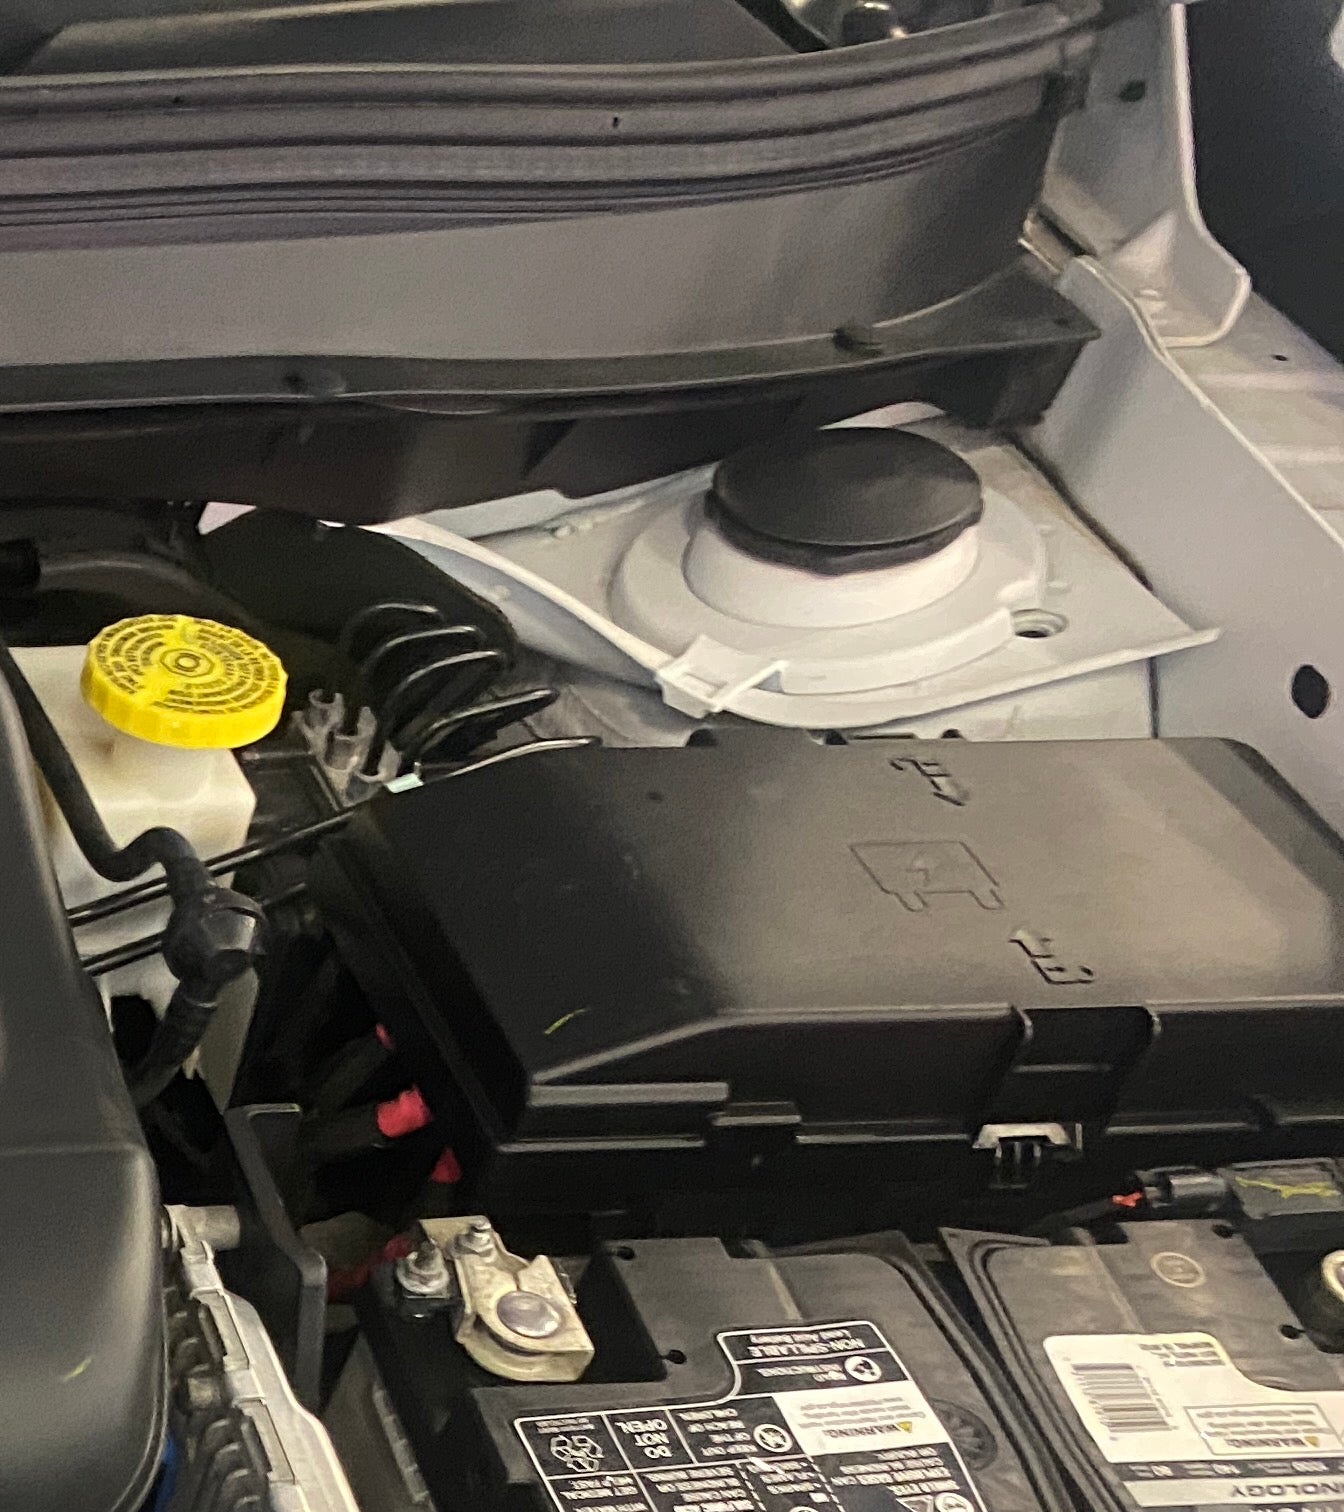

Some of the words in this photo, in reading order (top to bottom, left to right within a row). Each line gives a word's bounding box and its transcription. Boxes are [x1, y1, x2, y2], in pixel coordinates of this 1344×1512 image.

[747, 1338, 865, 1357] NON-SPILLABLE
[615, 1419, 667, 1433] OPEN.
[634, 1432, 669, 1446] NOT
[644, 1446, 672, 1458] DO
[1231, 1480, 1344, 1497] NOLOGY
